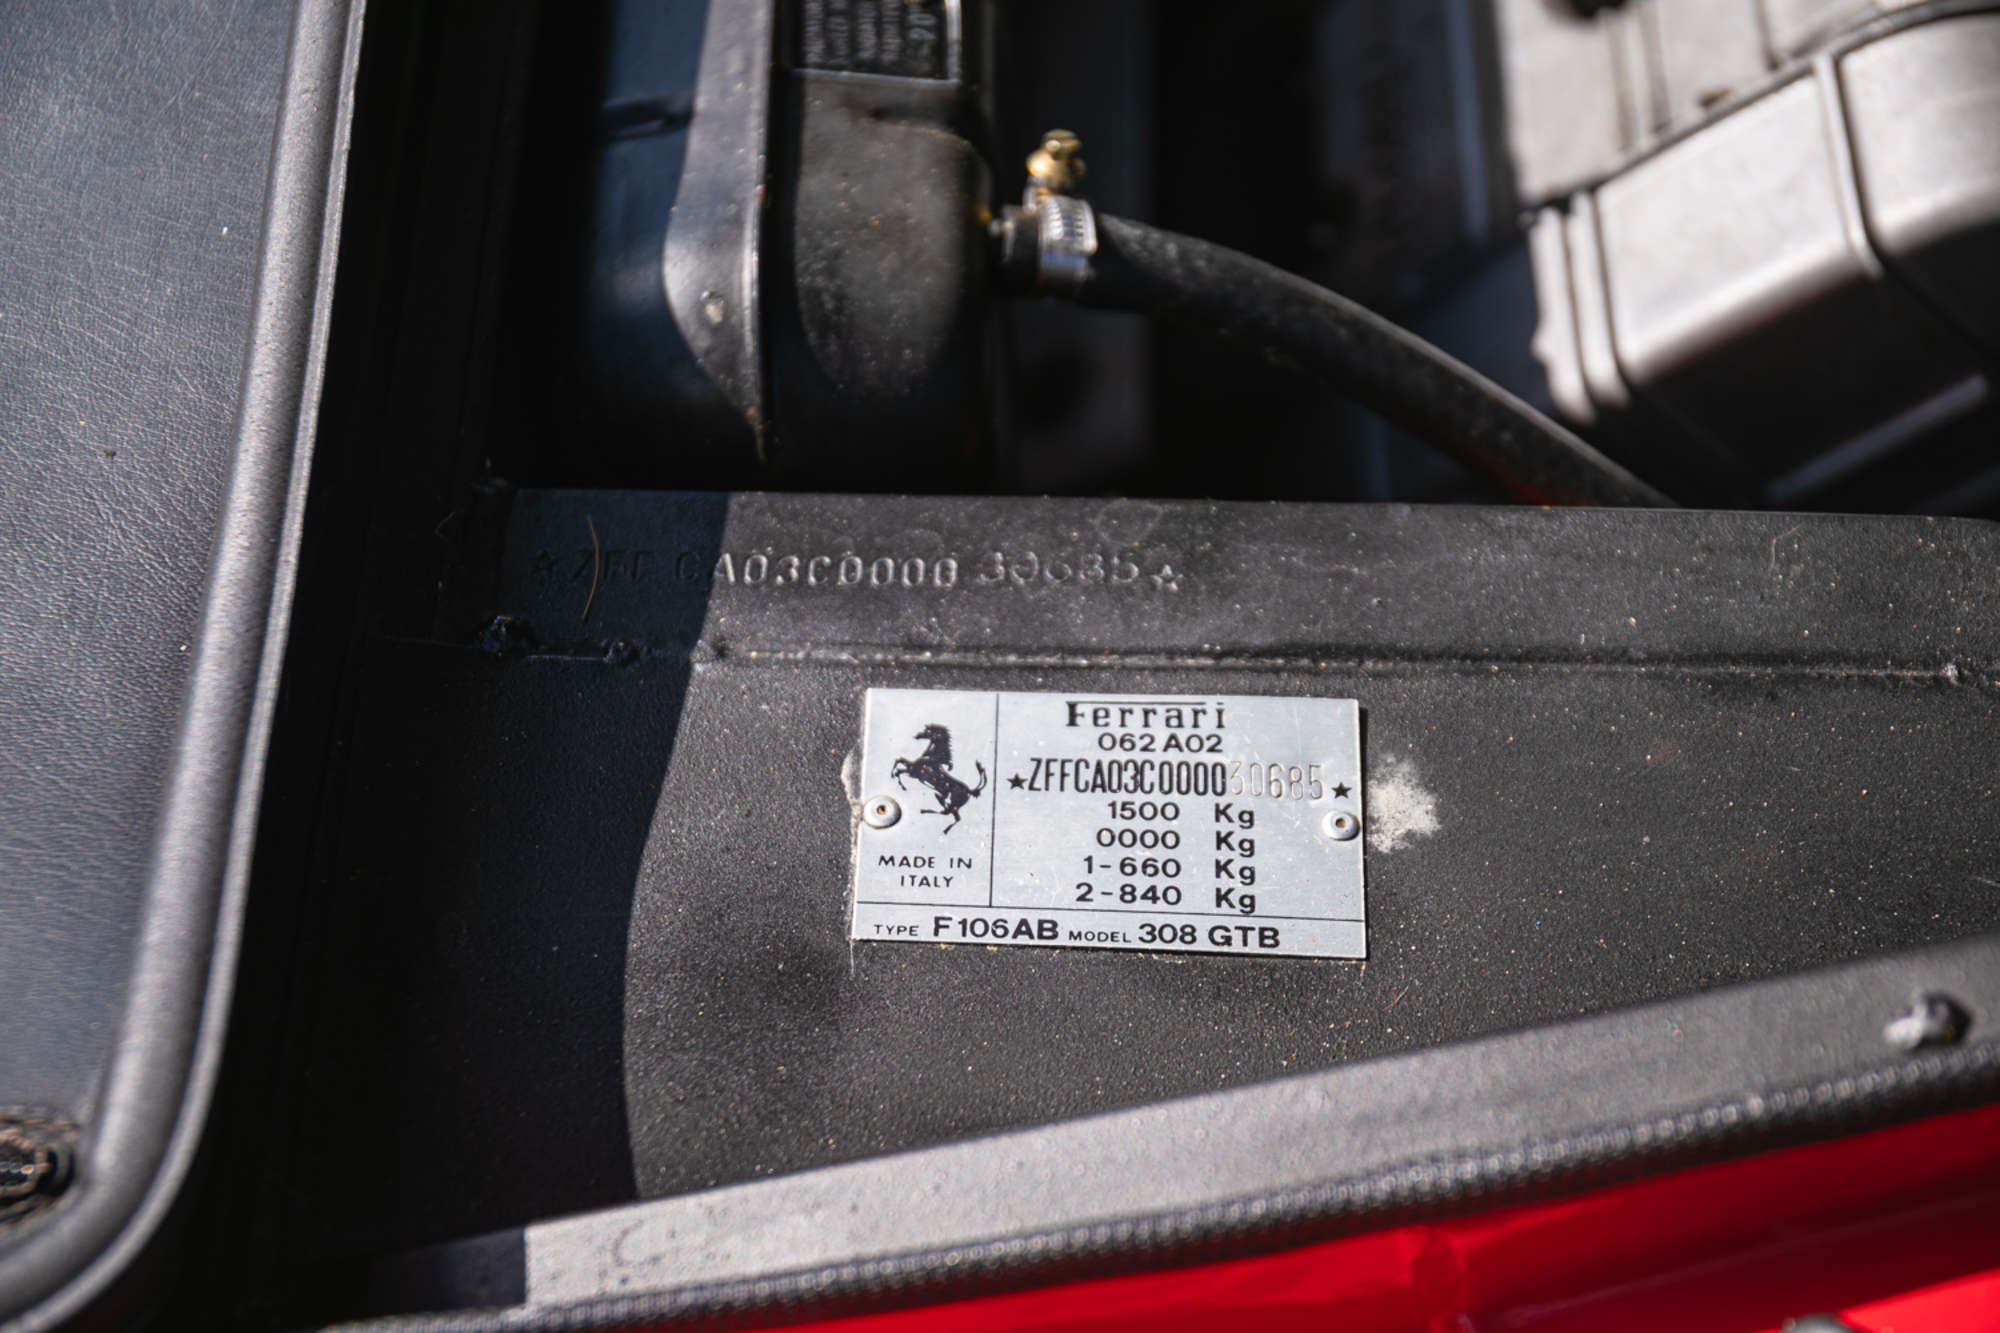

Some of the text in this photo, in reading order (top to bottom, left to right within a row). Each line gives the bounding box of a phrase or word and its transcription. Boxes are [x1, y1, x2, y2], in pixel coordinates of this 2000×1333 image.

[1065, 701, 1226, 729] Ferrari
[1108, 801, 1256, 830] 1500 Kg
[1096, 828, 1256, 858] 0000 Kg
[878, 855, 973, 870] MADE IN
[1215, 858, 1256, 886] Kg
[900, 875, 954, 888] ITALY
[1215, 887, 1256, 915] Kg
[873, 924, 920, 937] TYPE
[1068, 930, 1133, 943] MODEL
[1138, 922, 1198, 945] 308
[1208, 925, 1281, 949] GTB
